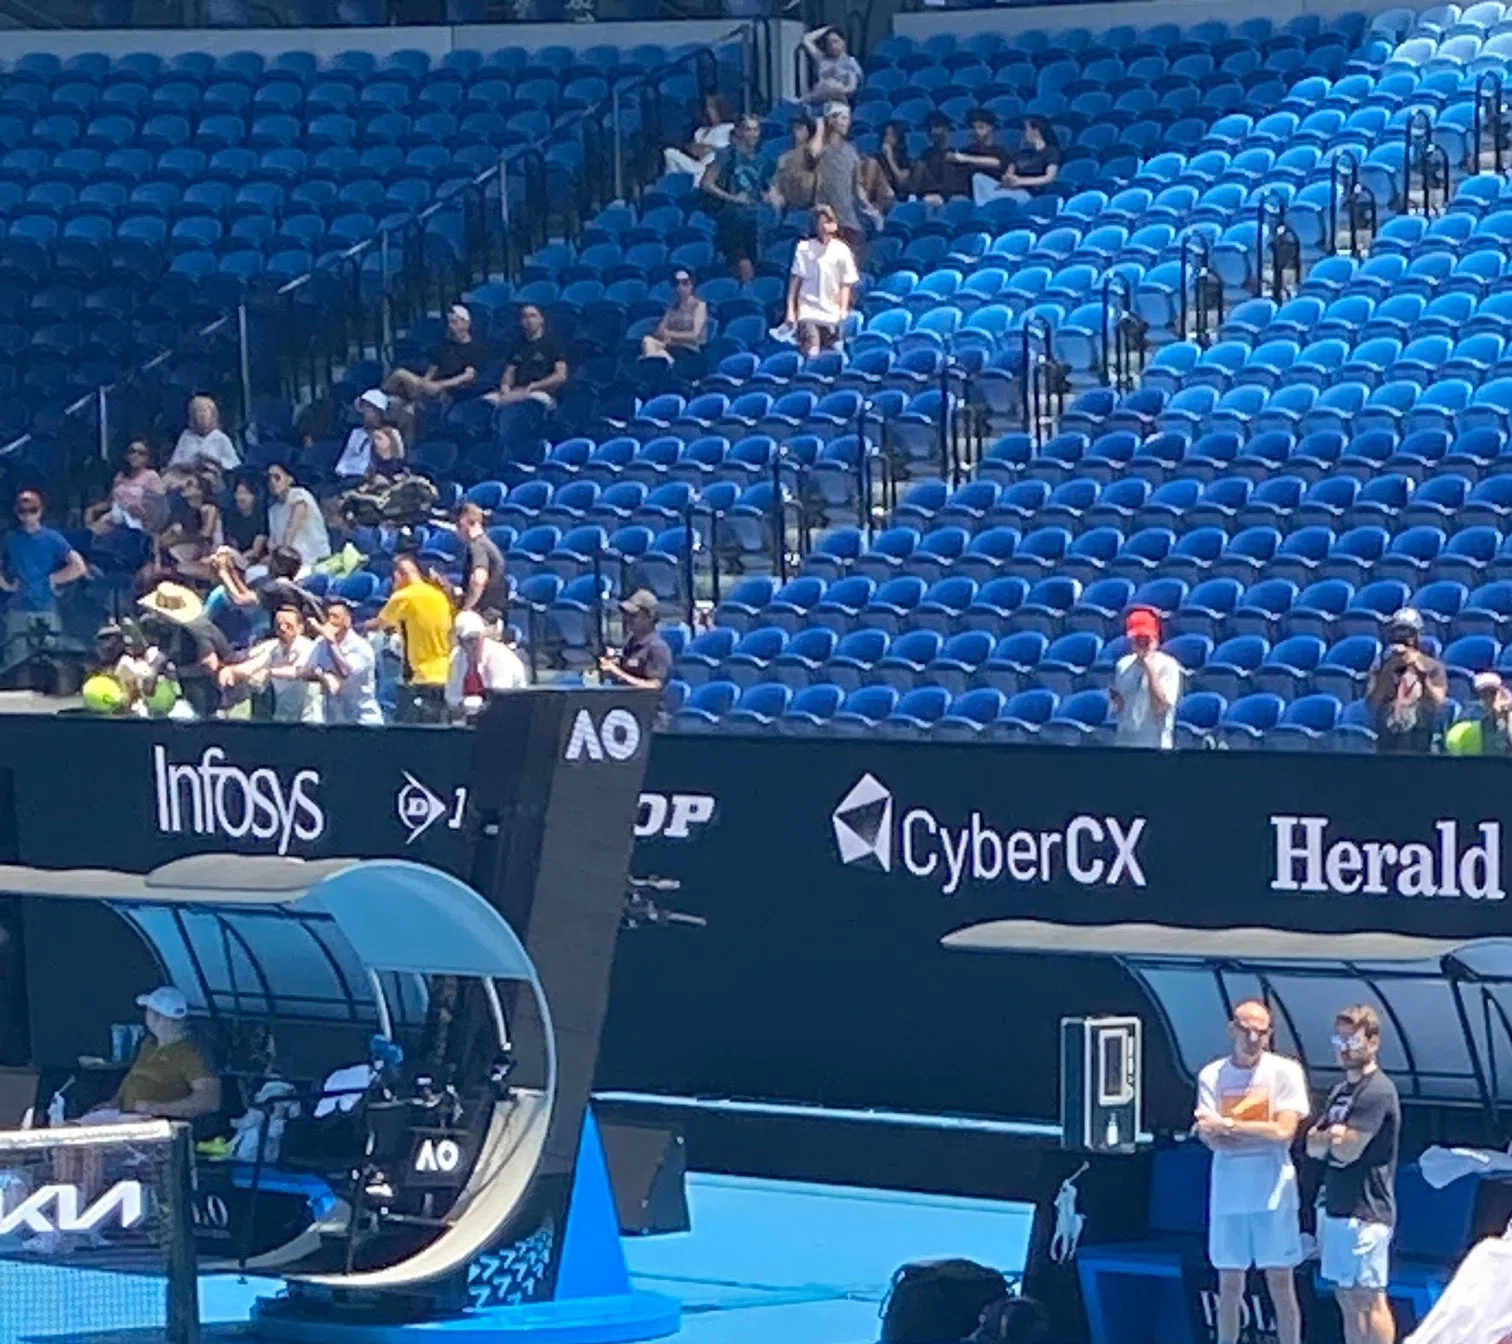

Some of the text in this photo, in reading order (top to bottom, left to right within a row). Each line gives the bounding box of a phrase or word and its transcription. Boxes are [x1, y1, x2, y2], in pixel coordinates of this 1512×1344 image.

[565, 709, 640, 760] AO
[154, 744, 324, 856] Infosys
[902, 808, 1147, 895] CyberCX
[1270, 815, 1506, 900] Herald
[415, 1138, 459, 1171] AO
